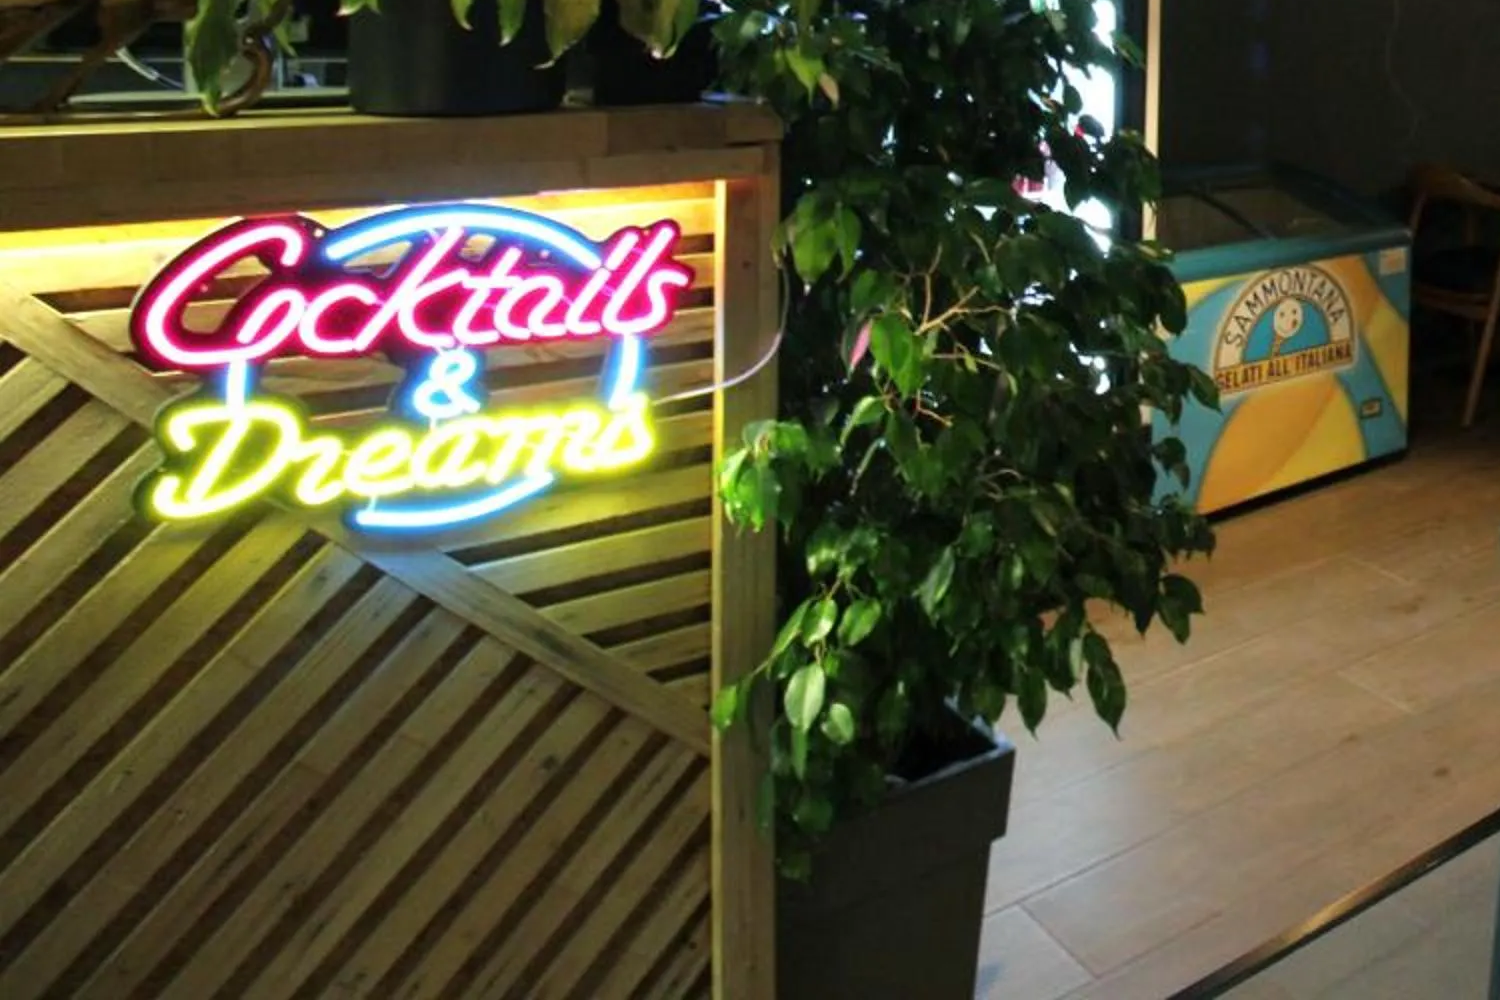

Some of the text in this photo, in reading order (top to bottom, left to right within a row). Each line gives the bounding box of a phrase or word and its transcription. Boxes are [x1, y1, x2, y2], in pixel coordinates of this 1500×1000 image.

[143, 221, 692, 368] Cocktails
[1225, 269, 1346, 348] SAMMONTANA
[411, 349, 482, 420] &
[1216, 364, 1264, 390] GELATI
[150, 394, 656, 520] Dreams
